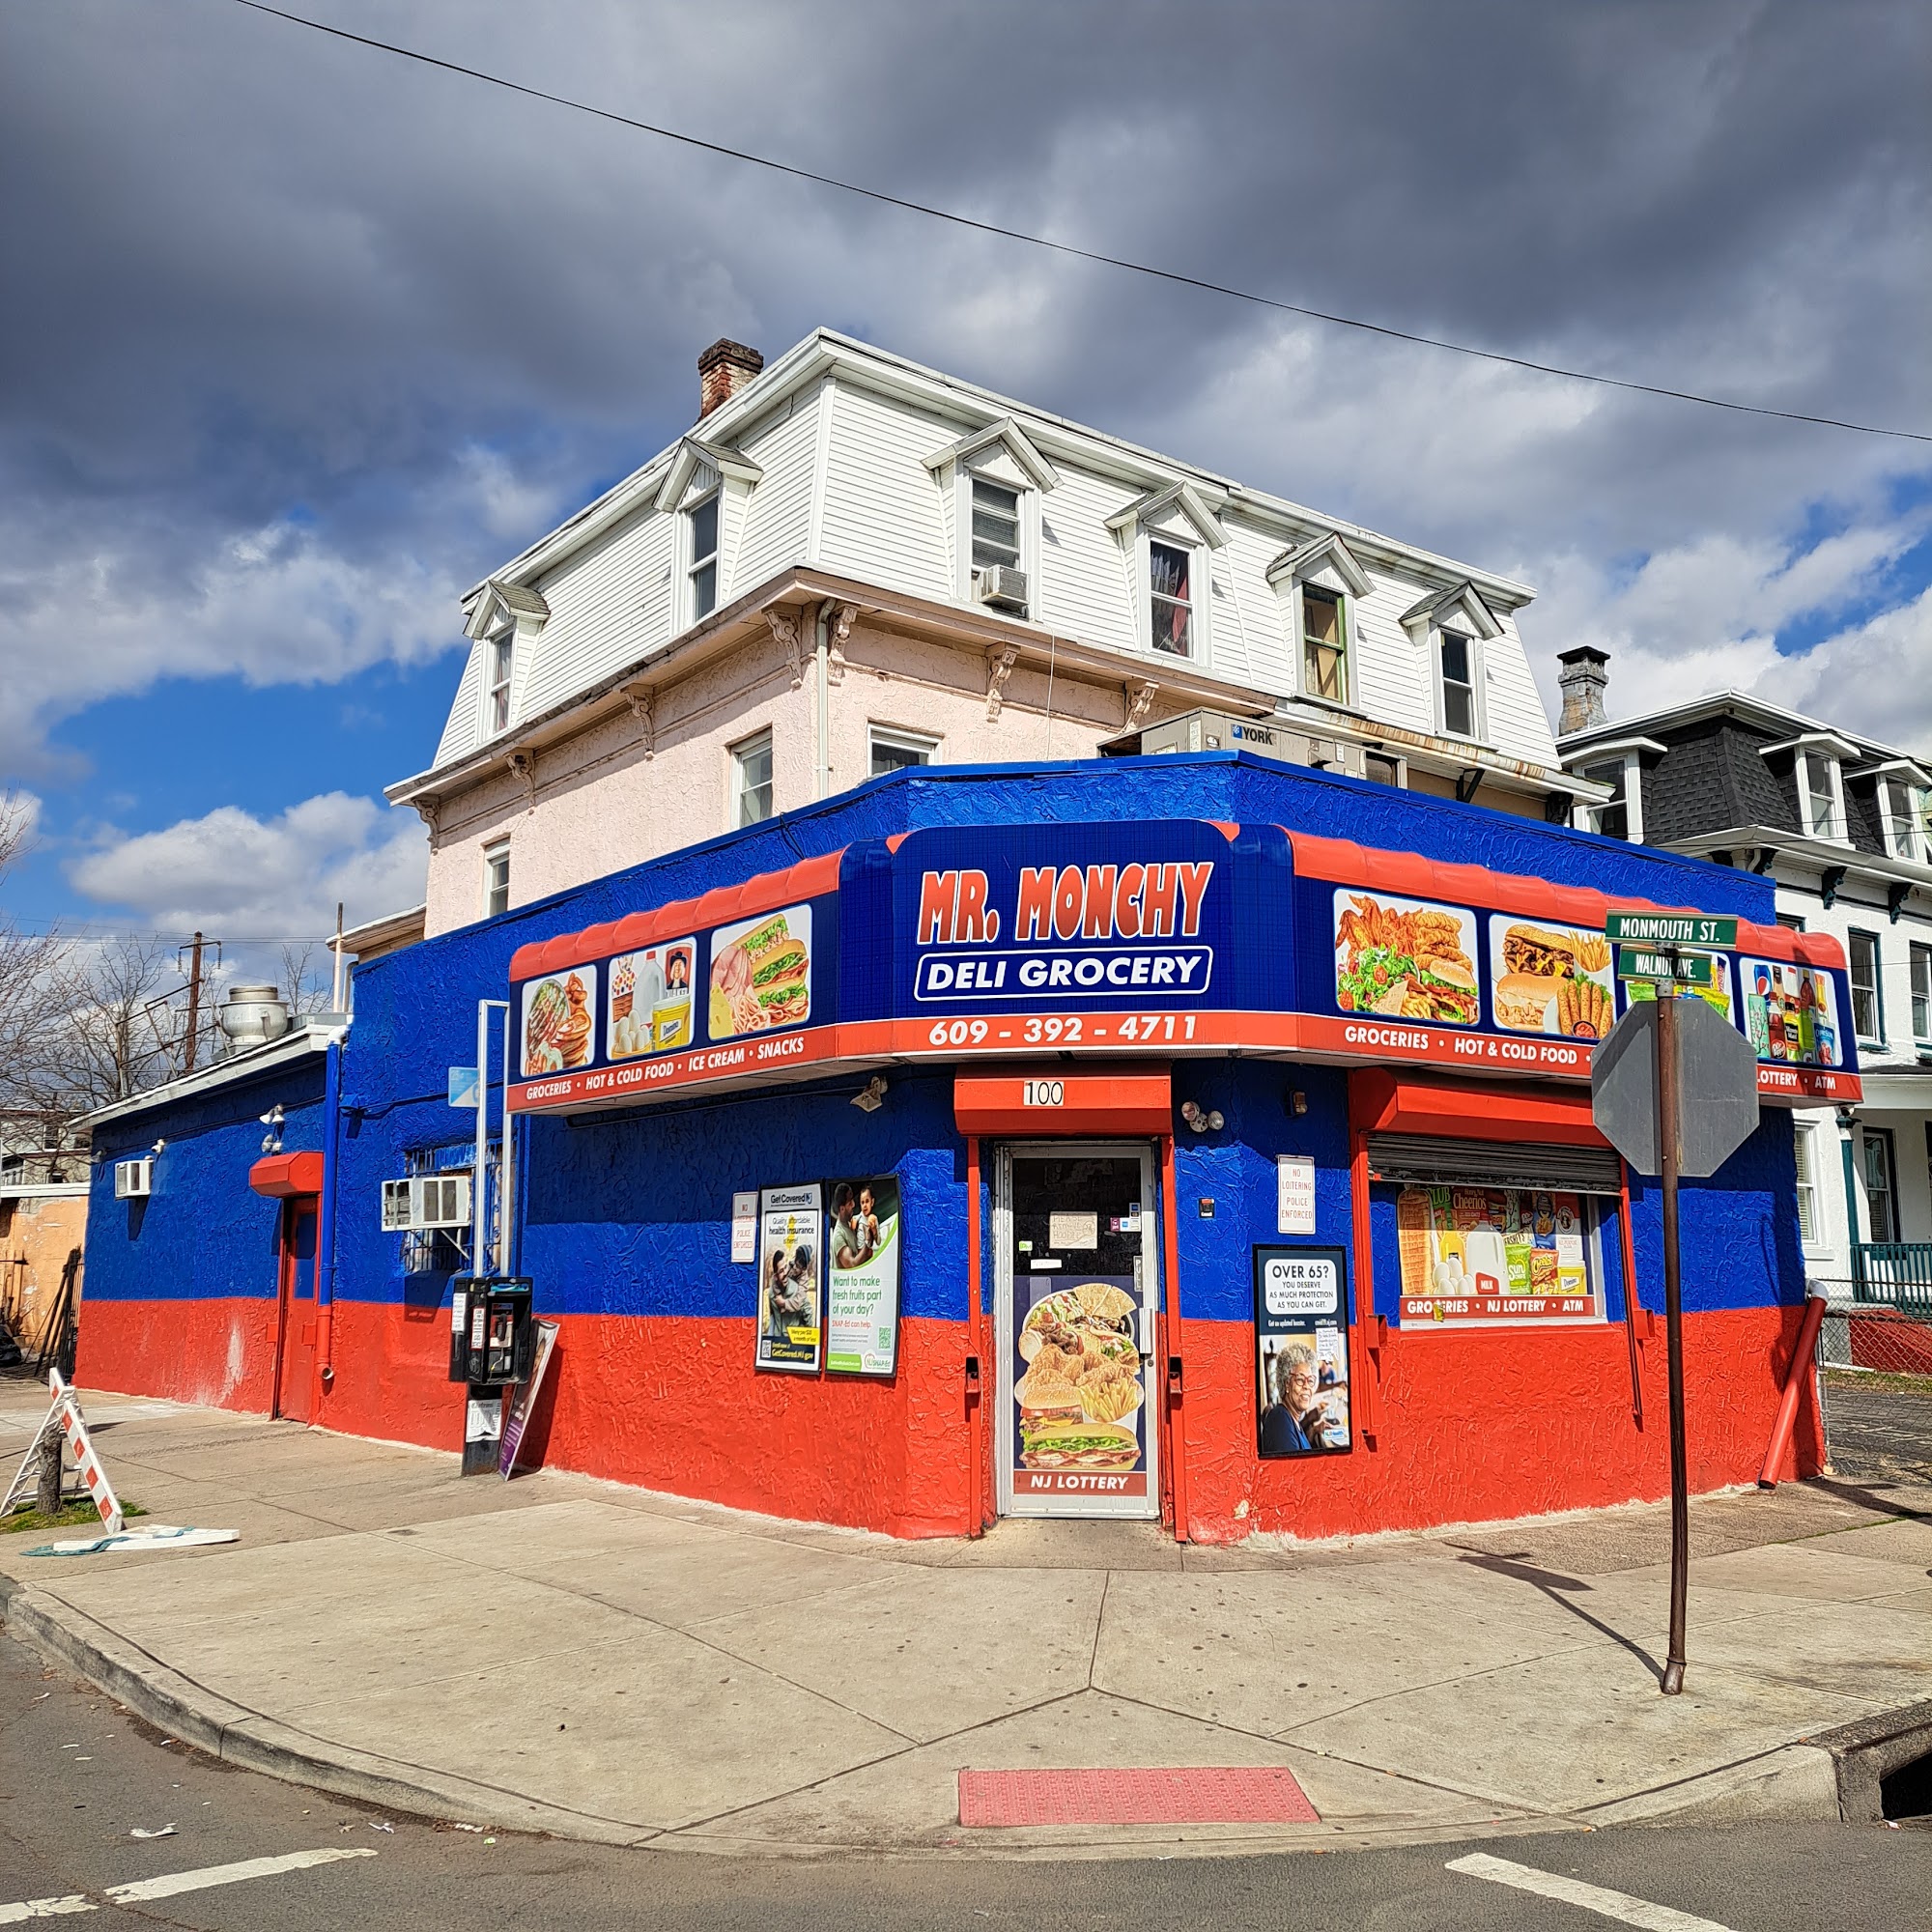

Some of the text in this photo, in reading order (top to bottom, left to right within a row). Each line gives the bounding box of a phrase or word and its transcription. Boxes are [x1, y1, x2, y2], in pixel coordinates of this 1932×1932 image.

[1242, 726, 1273, 745] YORK
[918, 862, 1214, 945] MR. MONCHY
[1620, 918, 1720, 942] MONMOUTH ST.
[927, 955, 1203, 990] DELI GROCERY
[1635, 953, 1697, 979] WALNUT AVE.
[928, 1020, 988, 1046] 609
[1023, 1017, 1083, 1042] 392
[1118, 1015, 1197, 1040] 4711
[1345, 1025, 1577, 1064] GROCERIES HOT & COLD FOOD
[526, 1037, 805, 1100] GROCERIES HOT & COLD FOOD ICE CREAM SNACKS
[1814, 1075, 1836, 1090] ATM
[1028, 1081, 1064, 1105] 100
[1292, 1168, 1301, 1178] NO
[1282, 1180, 1312, 1191] LOITERING
[1286, 1197, 1308, 1207] POLICE
[1453, 1192, 1487, 1210] Cheerios
[1281, 1209, 1313, 1219] ENFORCED
[769, 1226, 814, 1235] health insurance
[1272, 1264, 1329, 1279] OVER 65?
[833, 1274, 880, 1287] Want to make
[833, 1289, 882, 1303] fresh fruits part
[1269, 1291, 1278, 1299] AS
[1279, 1291, 1297, 1299] MUCH
[833, 1303, 874, 1318] of your day?
[1277, 1300, 1285, 1309] AS
[1287, 1300, 1299, 1309] YOU
[1406, 1299, 1584, 1314] GROERIES NJ LOTTERY ATM
[1031, 1474, 1128, 1490] NJ LOTTERY
